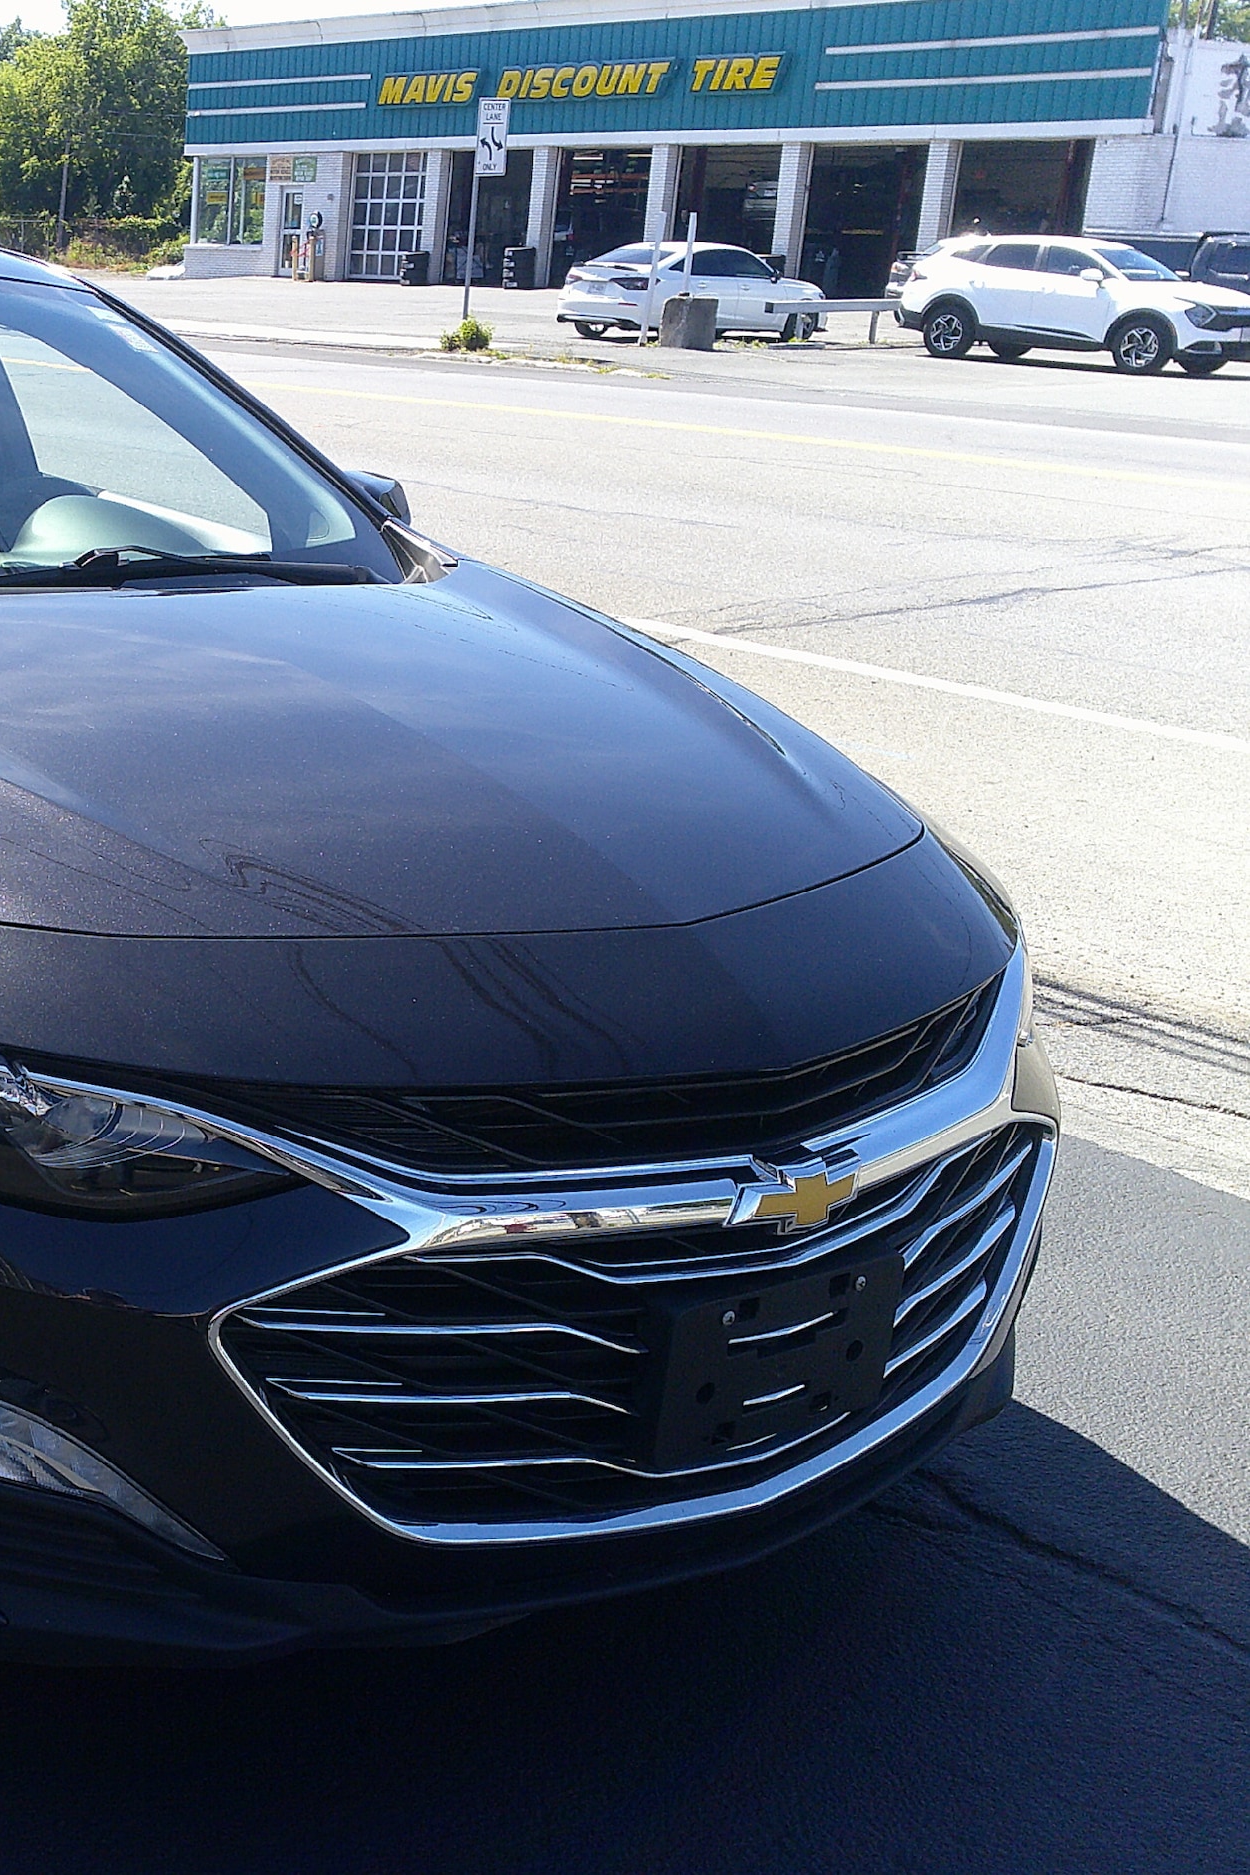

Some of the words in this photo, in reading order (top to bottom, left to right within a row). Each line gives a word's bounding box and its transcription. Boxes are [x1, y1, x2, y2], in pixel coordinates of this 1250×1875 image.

[378, 72, 478, 106] MAVIS
[497, 61, 670, 99] DISCOUNT
[692, 56, 781, 92] TIRE
[483, 103, 506, 111] CENTER
[485, 113, 502, 121] LANE
[482, 163, 497, 171] ONLY
